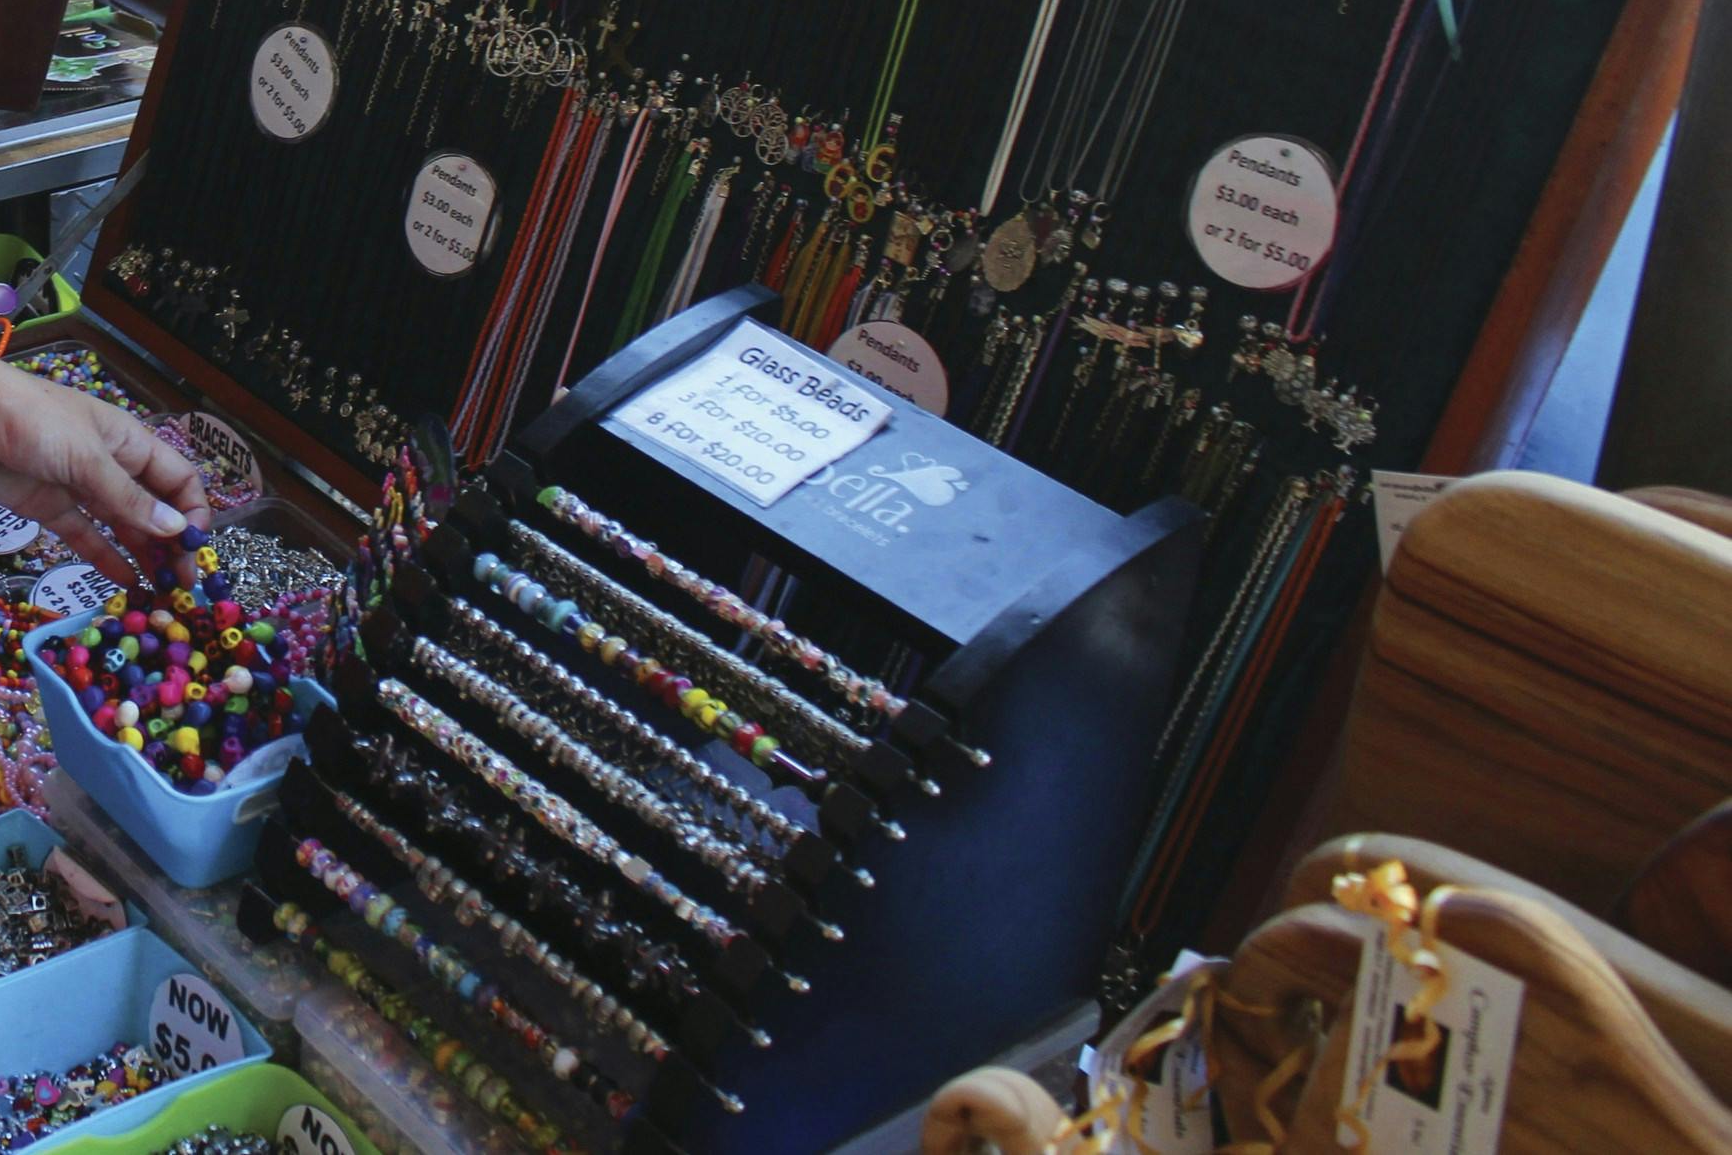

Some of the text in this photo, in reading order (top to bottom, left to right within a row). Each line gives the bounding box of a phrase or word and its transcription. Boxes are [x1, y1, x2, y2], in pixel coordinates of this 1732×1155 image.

[284, 31, 319, 74] Pendants
[270, 52, 310, 101] $3.00 each
[258, 76, 306, 134] or 2 for $5.00
[432, 165, 477, 197] Pendants
[1228, 149, 1301, 187] Pendants
[422, 191, 474, 228] $3.00 each
[1215, 184, 1299, 227] $3.00 each
[412, 221, 476, 262] or 2 for $5.00
[1204, 223, 1311, 271] or 2 for $5.00
[858, 328, 921, 373] Pendants
[716, 375, 733, 387] 1
[769, 404, 831, 440] $5.00
[738, 346, 801, 385] Glass
[797, 375, 871, 423] Beads
[189, 410, 253, 475] BRACELETS
[646, 412, 666, 425] 8
[702, 442, 776, 486] $20.00
[678, 391, 697, 403] 3
[732, 419, 807, 463] $10.00
[41, 585, 56, 597] or
[50, 597, 65, 606] 2
[67, 581, 97, 608] $3.00
[80, 570, 121, 603] BRAC
[169, 977, 229, 1041] NOW
[301, 1106, 344, 1155] NO
